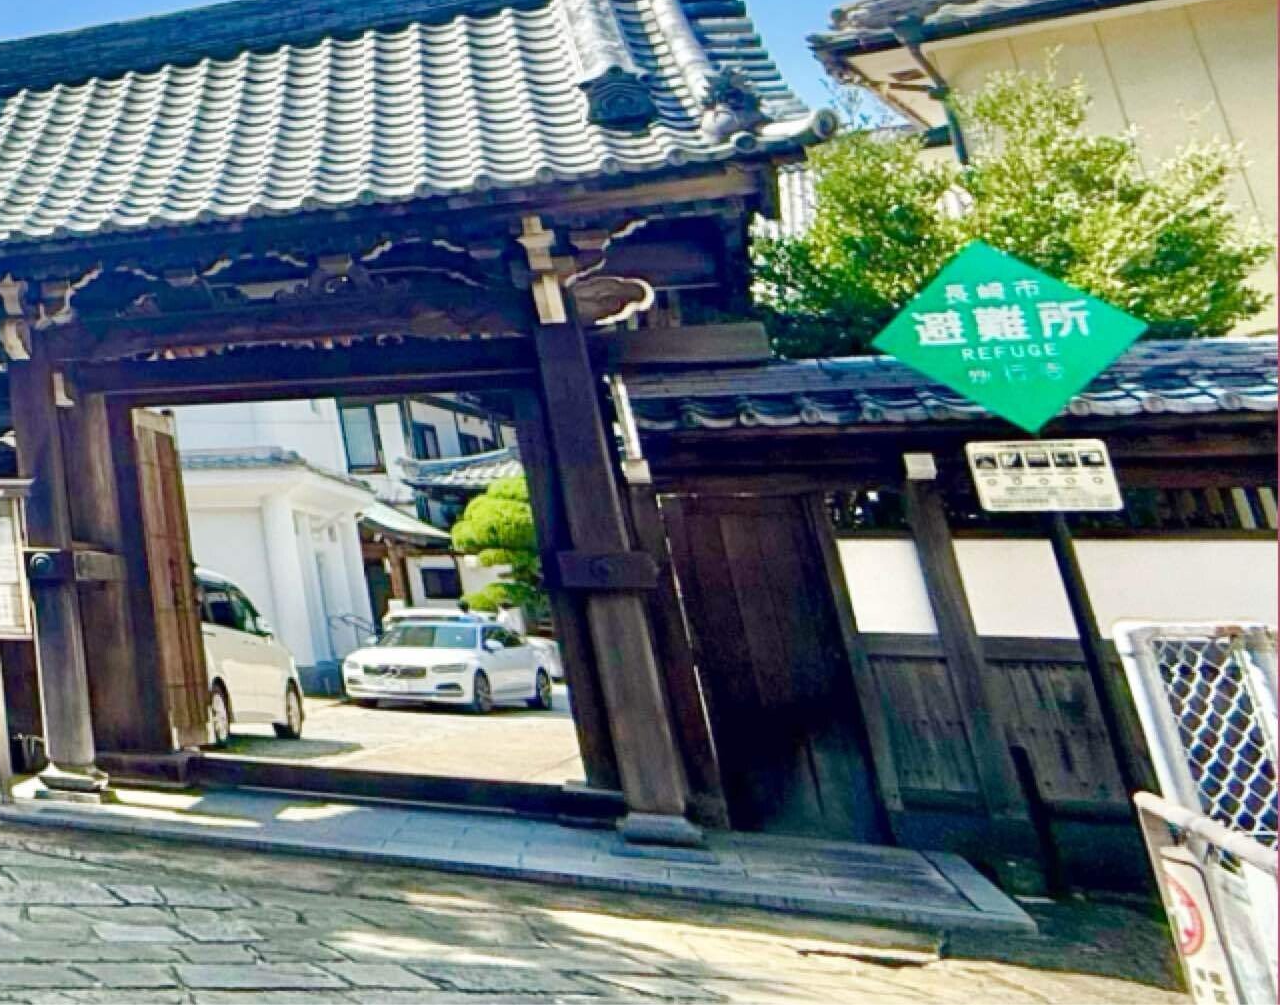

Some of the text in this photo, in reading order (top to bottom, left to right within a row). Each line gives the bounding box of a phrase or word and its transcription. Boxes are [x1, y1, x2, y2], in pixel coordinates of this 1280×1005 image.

[944, 279, 1040, 305] 長崎市
[911, 299, 1091, 347] 避難所
[961, 342, 1058, 361] REFUGE
